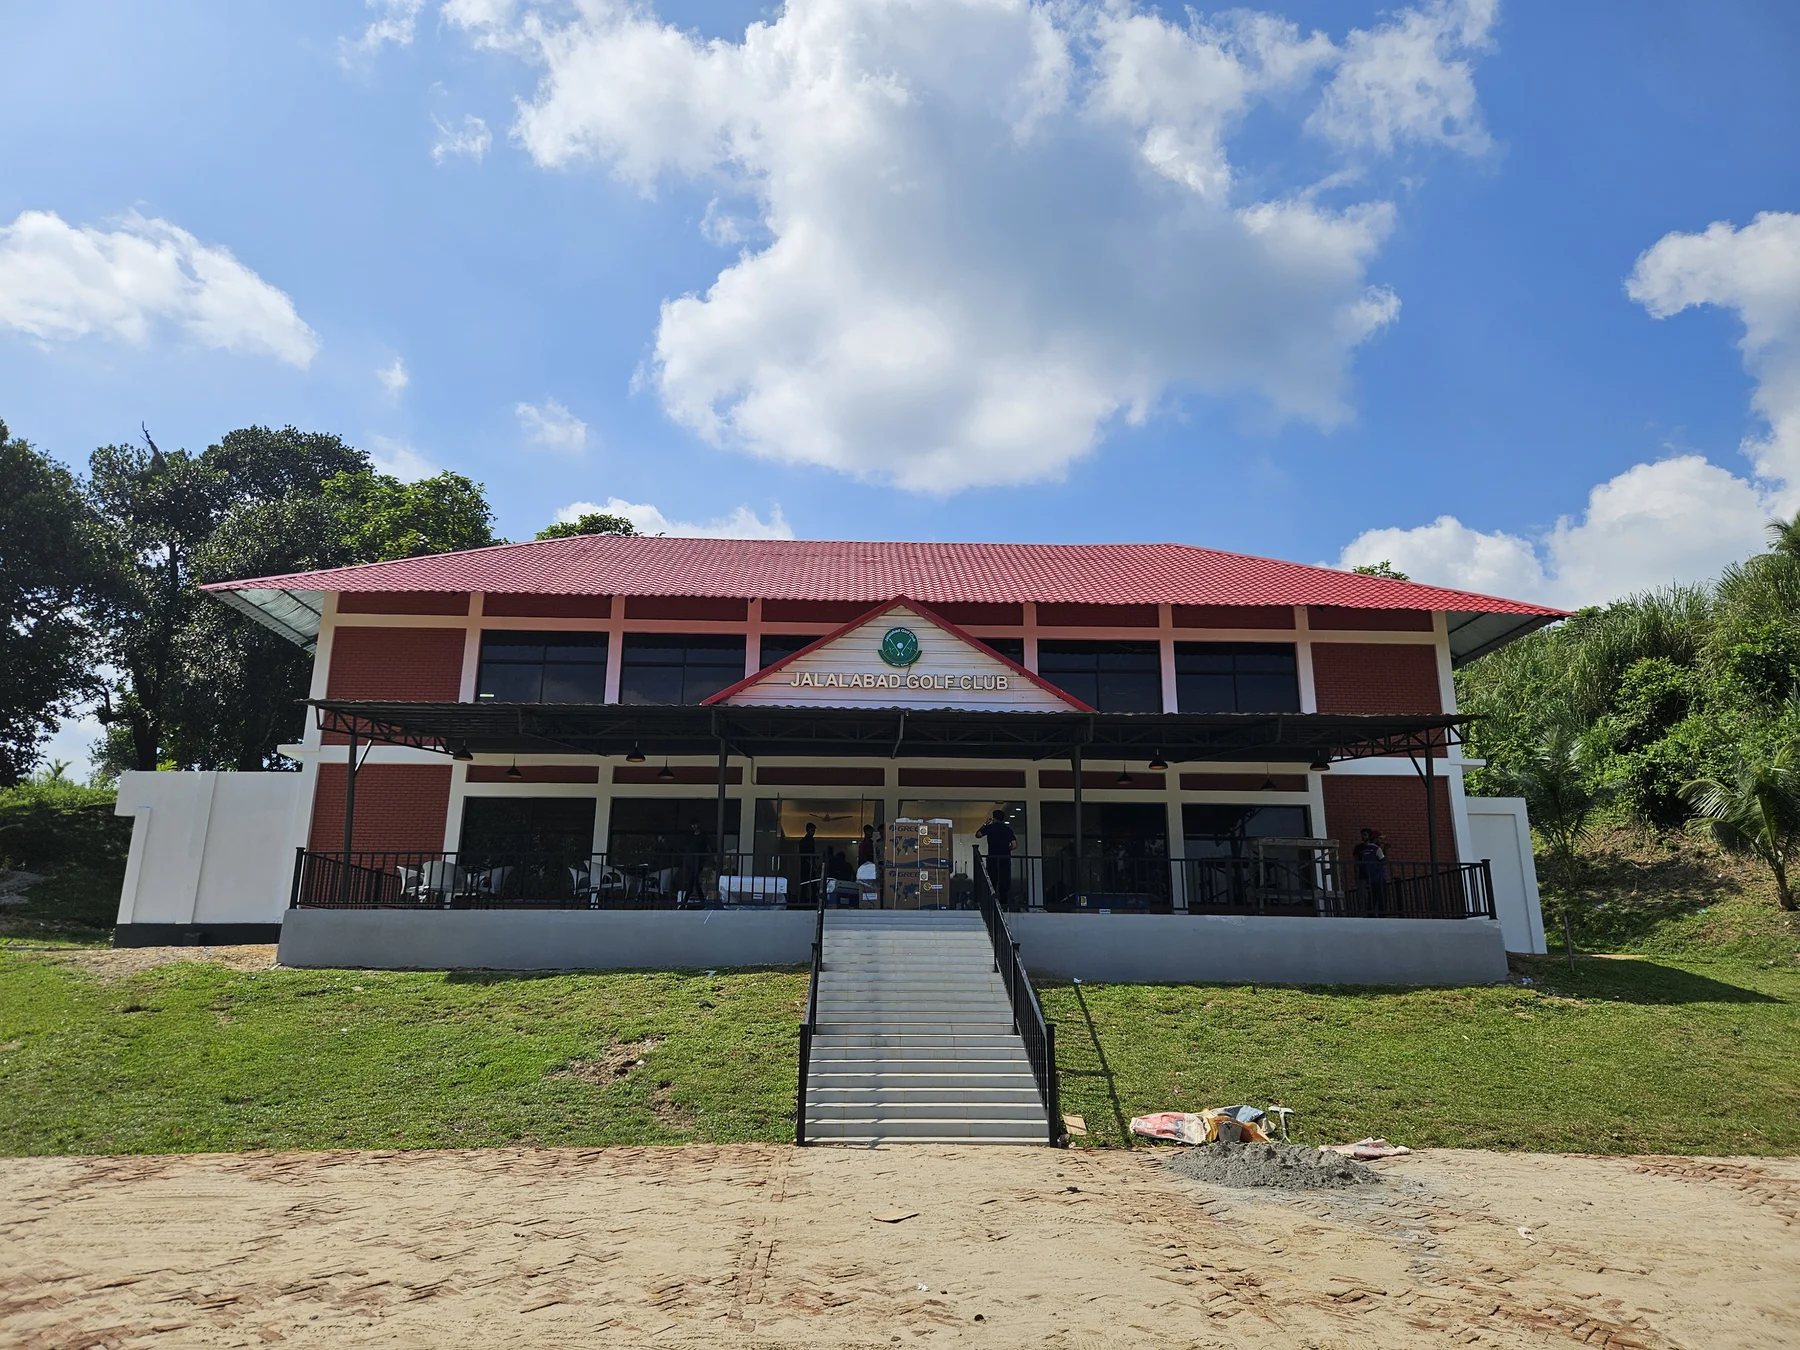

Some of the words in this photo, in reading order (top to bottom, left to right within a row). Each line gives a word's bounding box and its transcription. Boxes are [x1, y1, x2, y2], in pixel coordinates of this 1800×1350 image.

[790, 672, 900, 688] JALALABAD
[906, 674, 955, 690] GOLF
[960, 675, 1009, 691] CLUB
